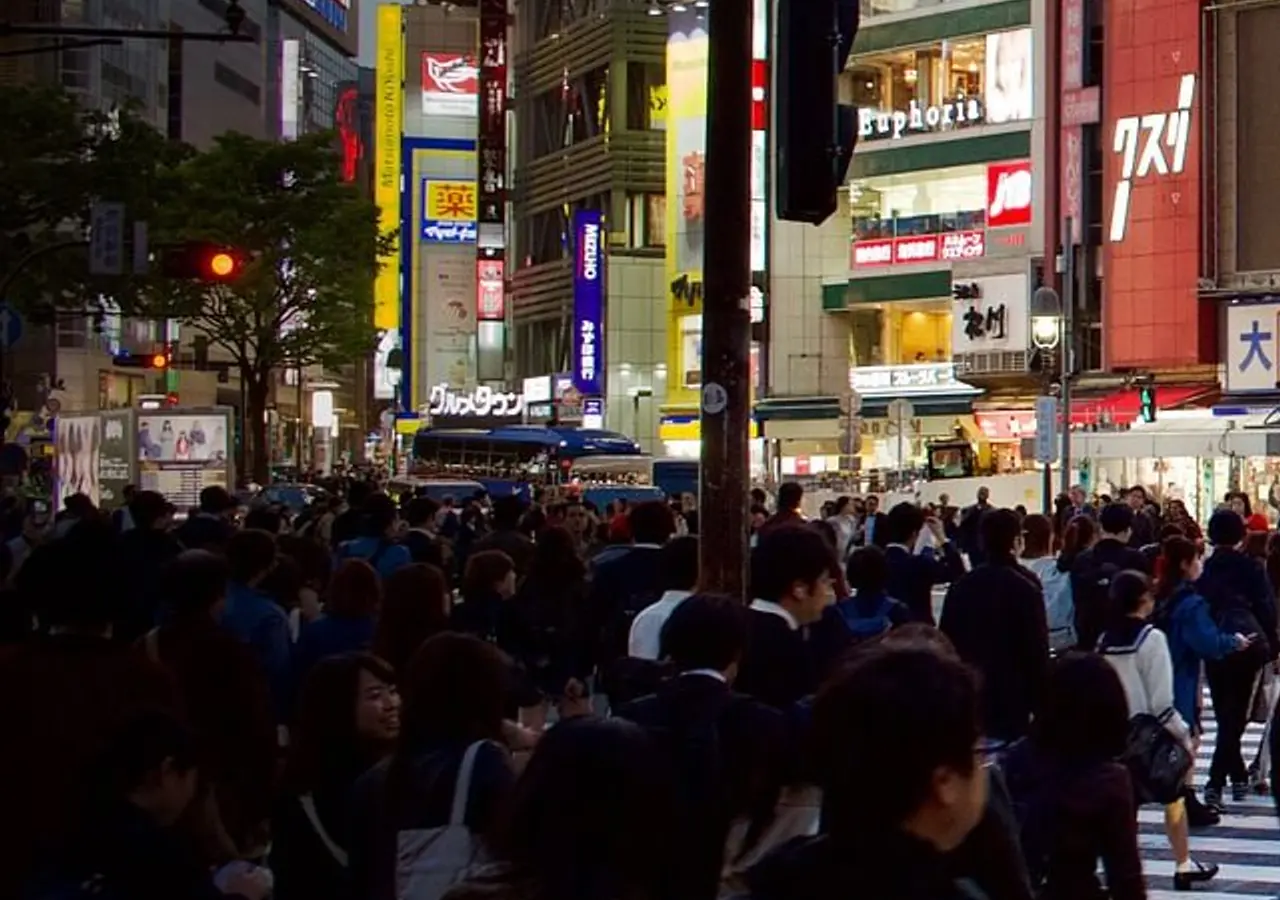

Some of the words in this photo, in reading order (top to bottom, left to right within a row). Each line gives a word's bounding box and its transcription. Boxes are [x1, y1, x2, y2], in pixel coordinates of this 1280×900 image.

[858, 93, 981, 139] Euphoria
[584, 223, 599, 280] MIZUHO
[430, 383, 525, 416] グルメタウン
